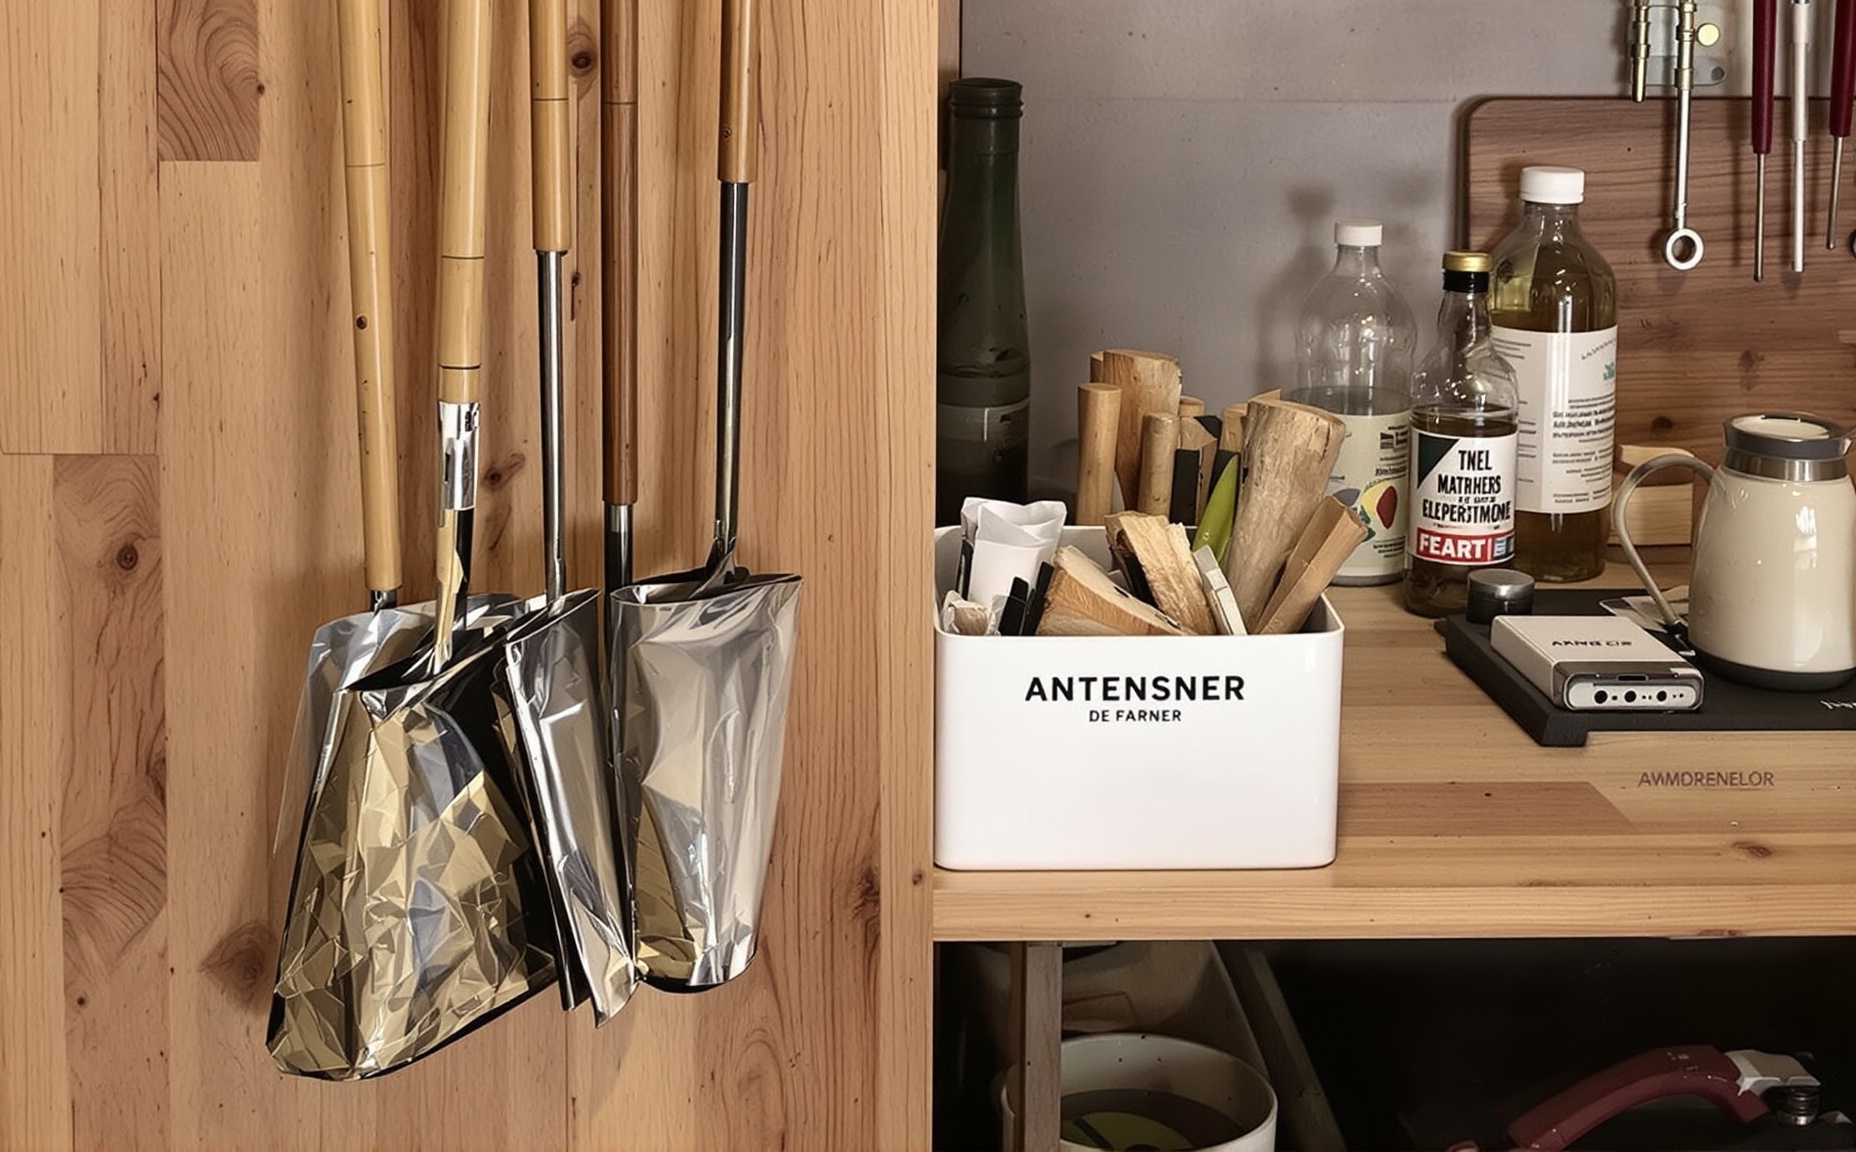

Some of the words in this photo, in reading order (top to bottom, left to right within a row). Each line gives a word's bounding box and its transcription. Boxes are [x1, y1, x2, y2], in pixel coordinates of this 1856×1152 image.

[1419, 532, 1486, 559] FEART
[1025, 675, 1246, 702] ANTENSNER
[1088, 709, 1110, 723] DE
[1115, 709, 1182, 723] FARNER
